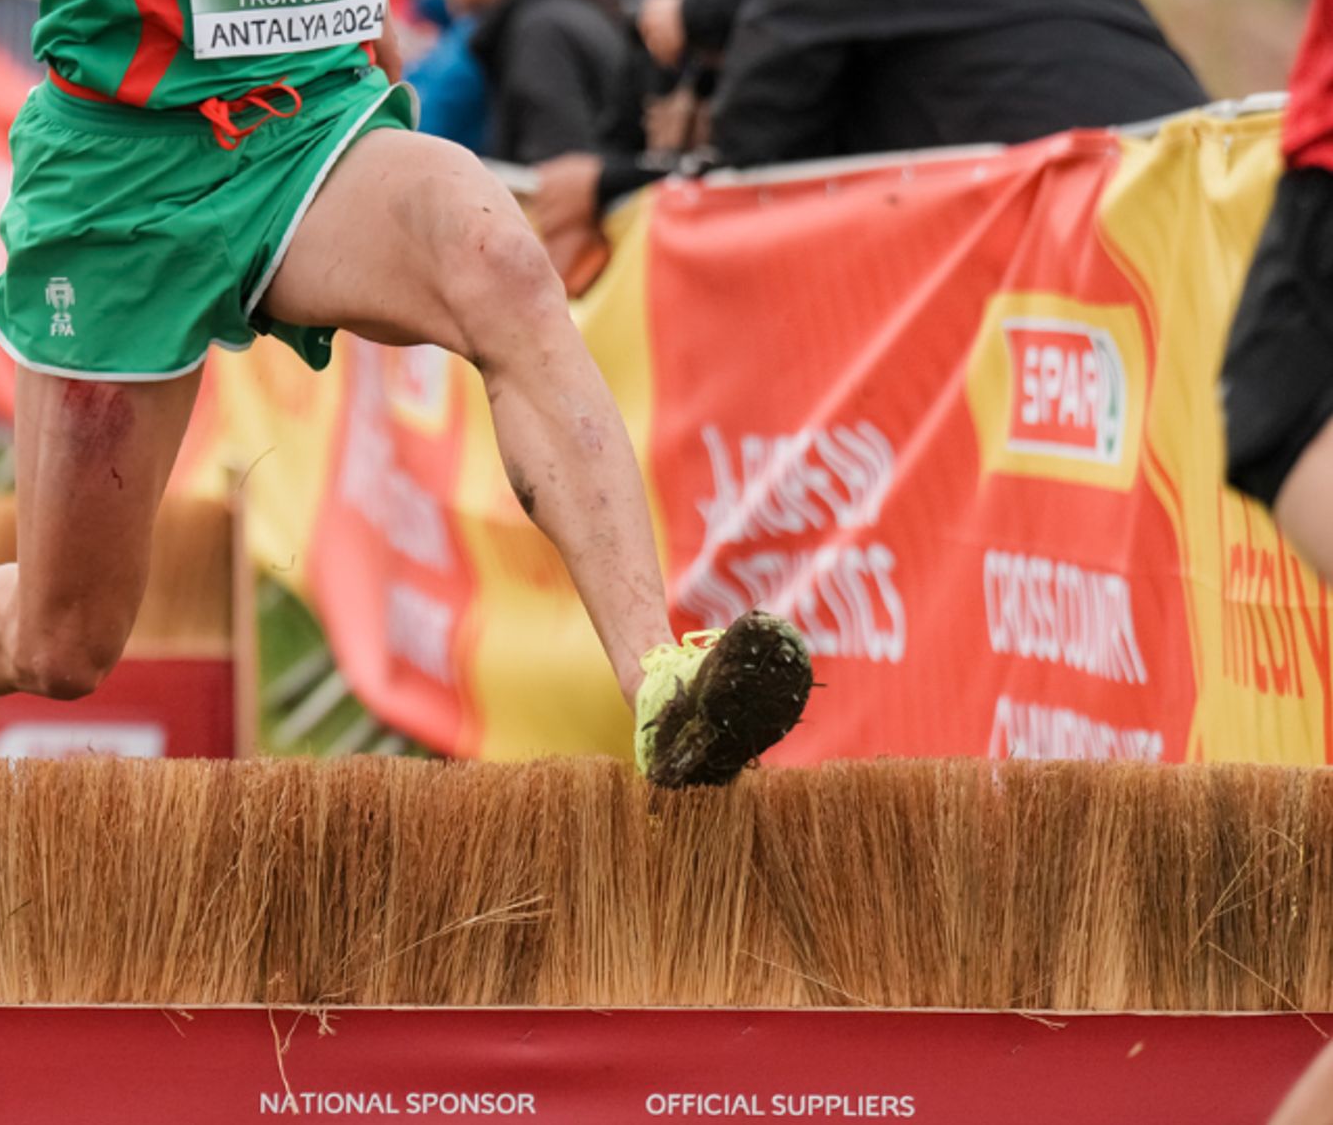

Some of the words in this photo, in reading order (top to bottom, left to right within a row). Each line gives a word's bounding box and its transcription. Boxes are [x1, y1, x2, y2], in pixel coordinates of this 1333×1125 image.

[211, 14, 328, 49] ANTALYA
[333, 2, 384, 37] 2024
[1022, 345, 1099, 427] SPAR
[259, 1092, 399, 1115] NATIONAL
[405, 1092, 536, 1115] SPONSOR
[645, 1093, 765, 1116] OFFICIAL
[771, 1093, 915, 1117] SUPPLIERS
